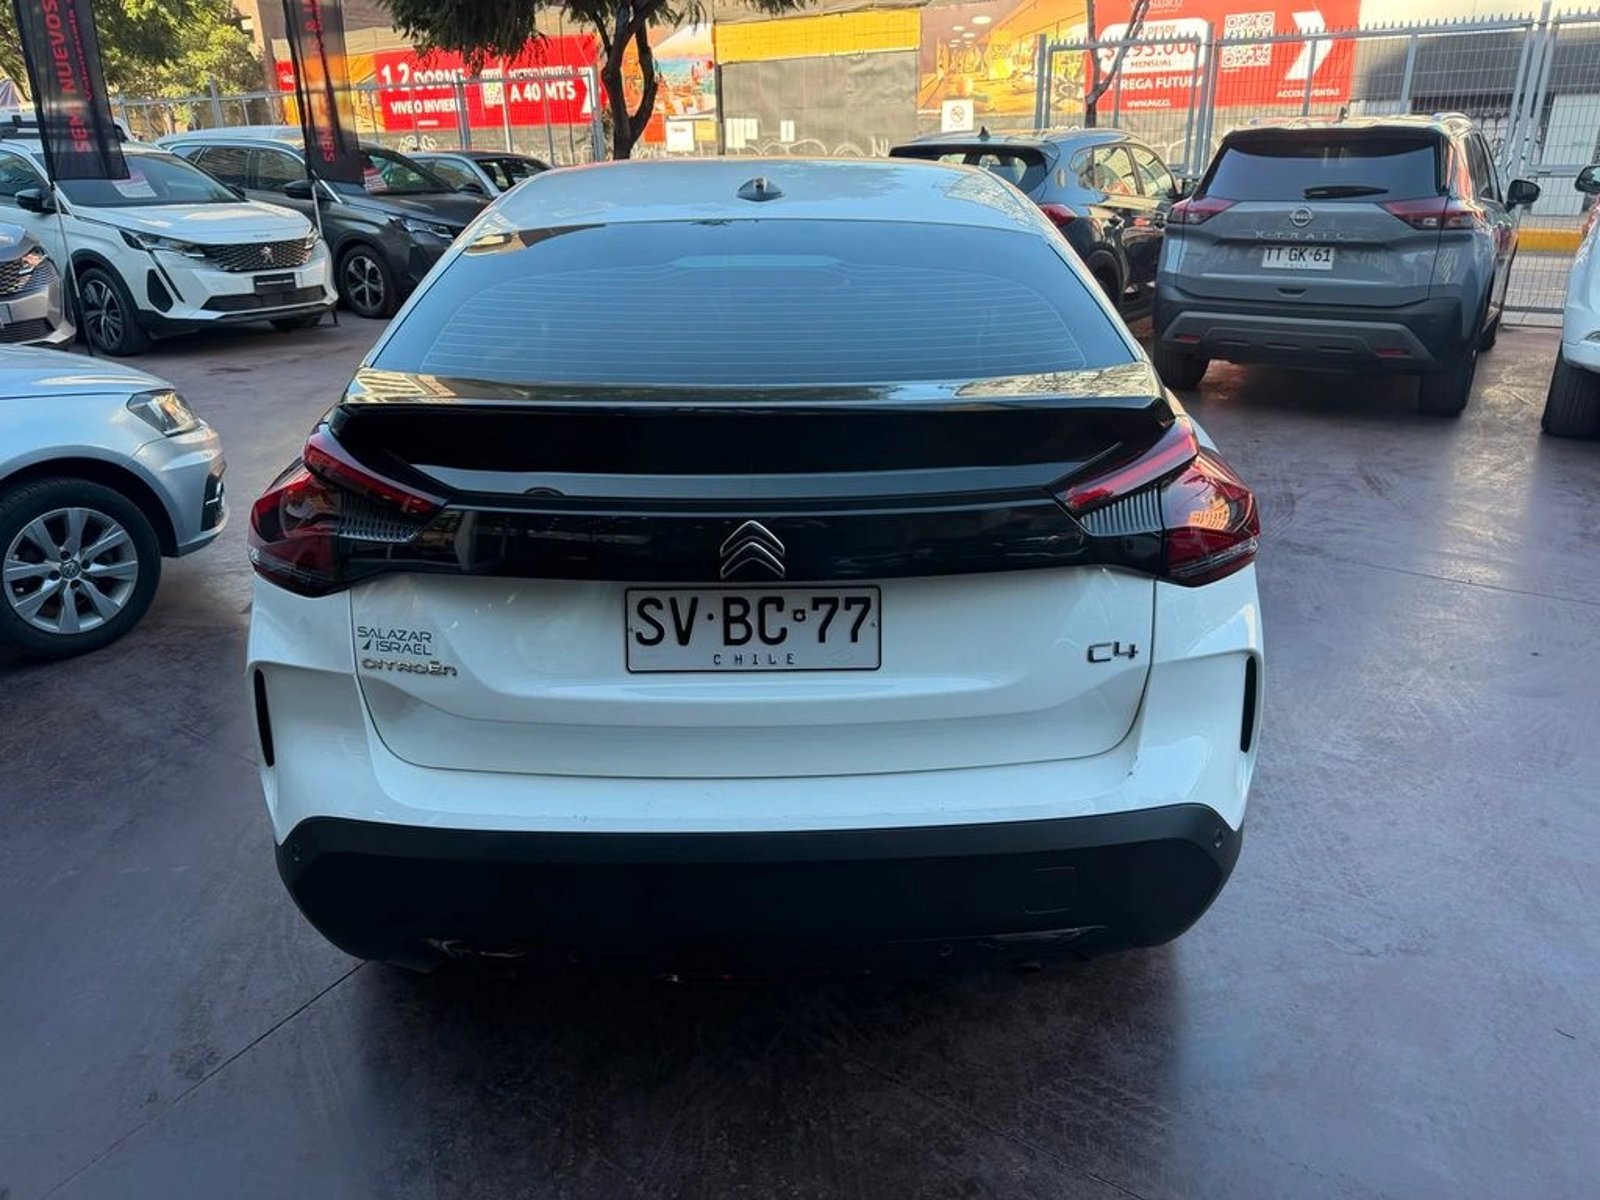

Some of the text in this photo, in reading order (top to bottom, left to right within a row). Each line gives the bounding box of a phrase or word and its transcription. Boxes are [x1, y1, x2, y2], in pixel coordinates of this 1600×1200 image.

[41, 0, 76, 93] NUEVOS
[1130, 60, 1173, 68] MENSUAL
[511, 80, 576, 103] A 40 MTS
[390, 100, 413, 115] VIVE
[414, 99, 423, 113] O
[1255, 230, 1345, 240] X-TRAIL
[357, 626, 432, 643] SALAZAR
[376, 640, 432, 656] ISRAEL
[1087, 641, 1139, 663] C4
[713, 654, 796, 666] CHILE
